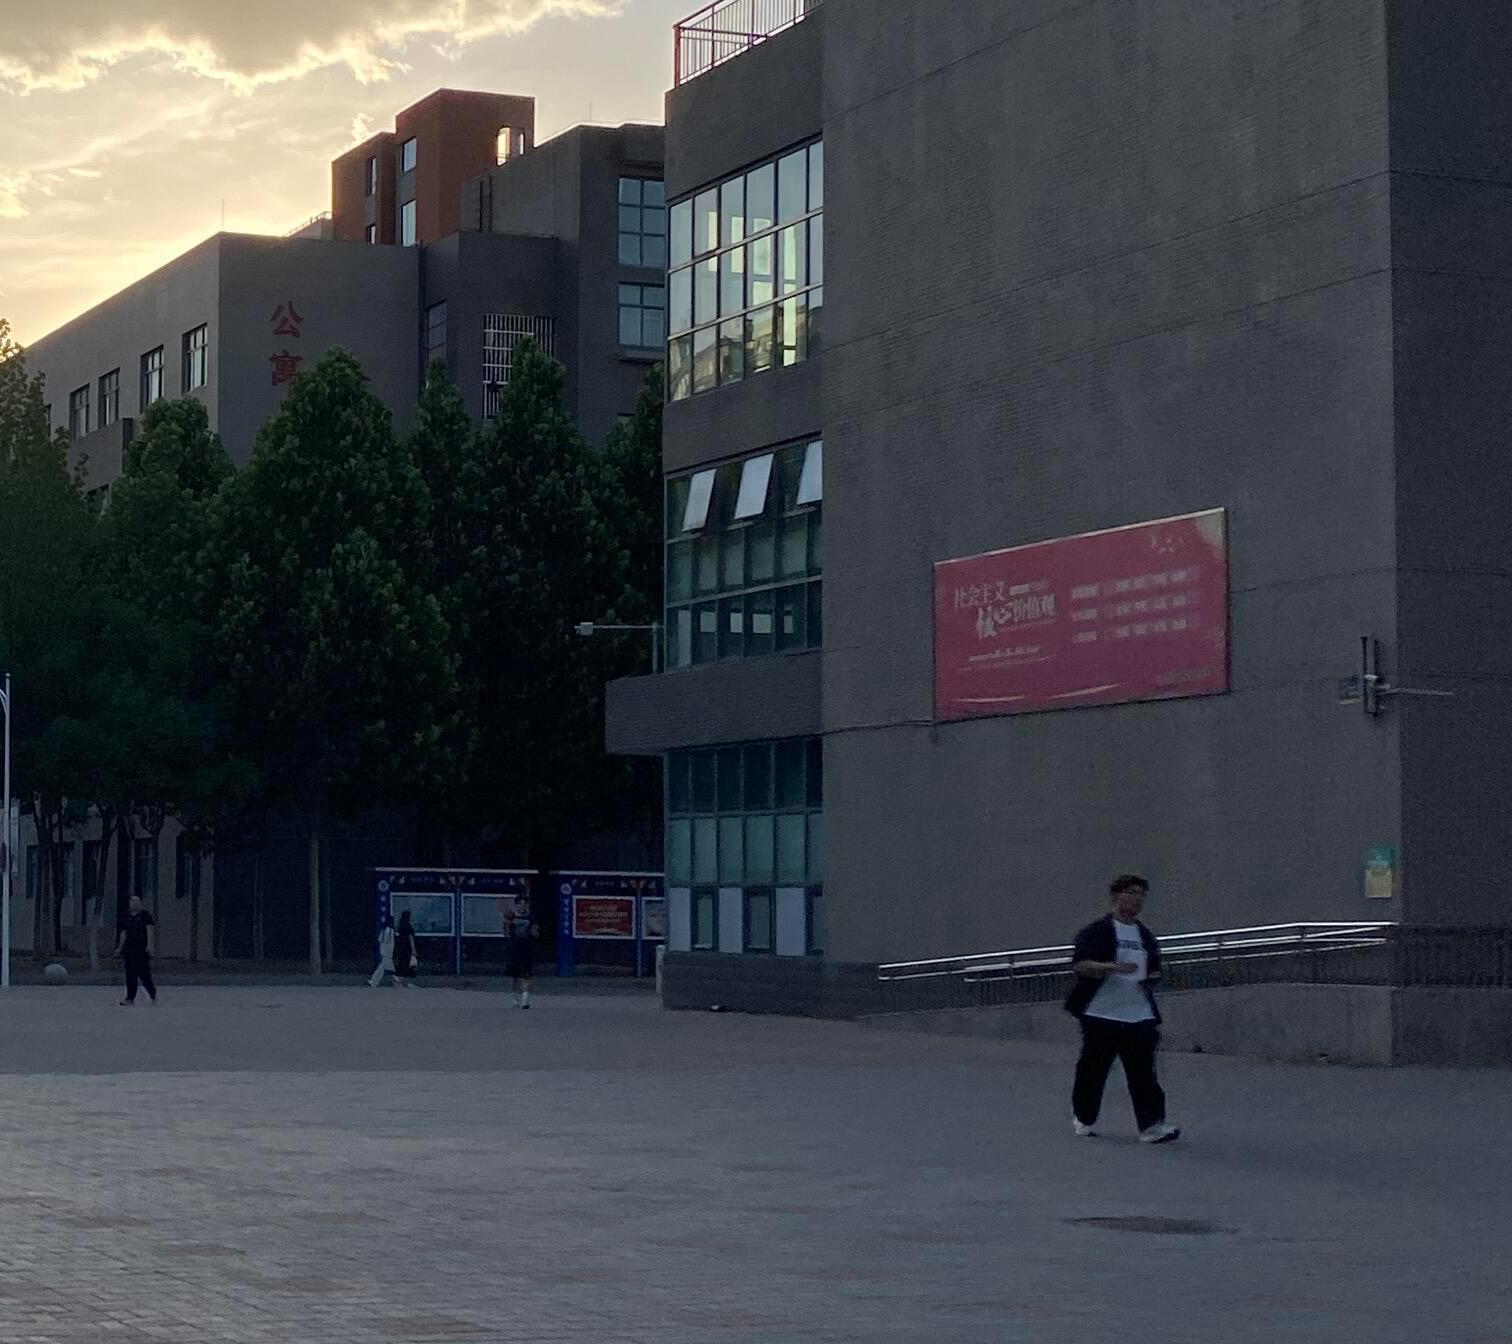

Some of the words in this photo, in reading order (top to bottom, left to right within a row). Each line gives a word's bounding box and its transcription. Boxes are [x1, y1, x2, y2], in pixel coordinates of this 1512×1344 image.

[269, 300, 305, 386] 公寓
[953, 580, 1008, 608] 社会主义
[976, 593, 1056, 639] 核心价值观
